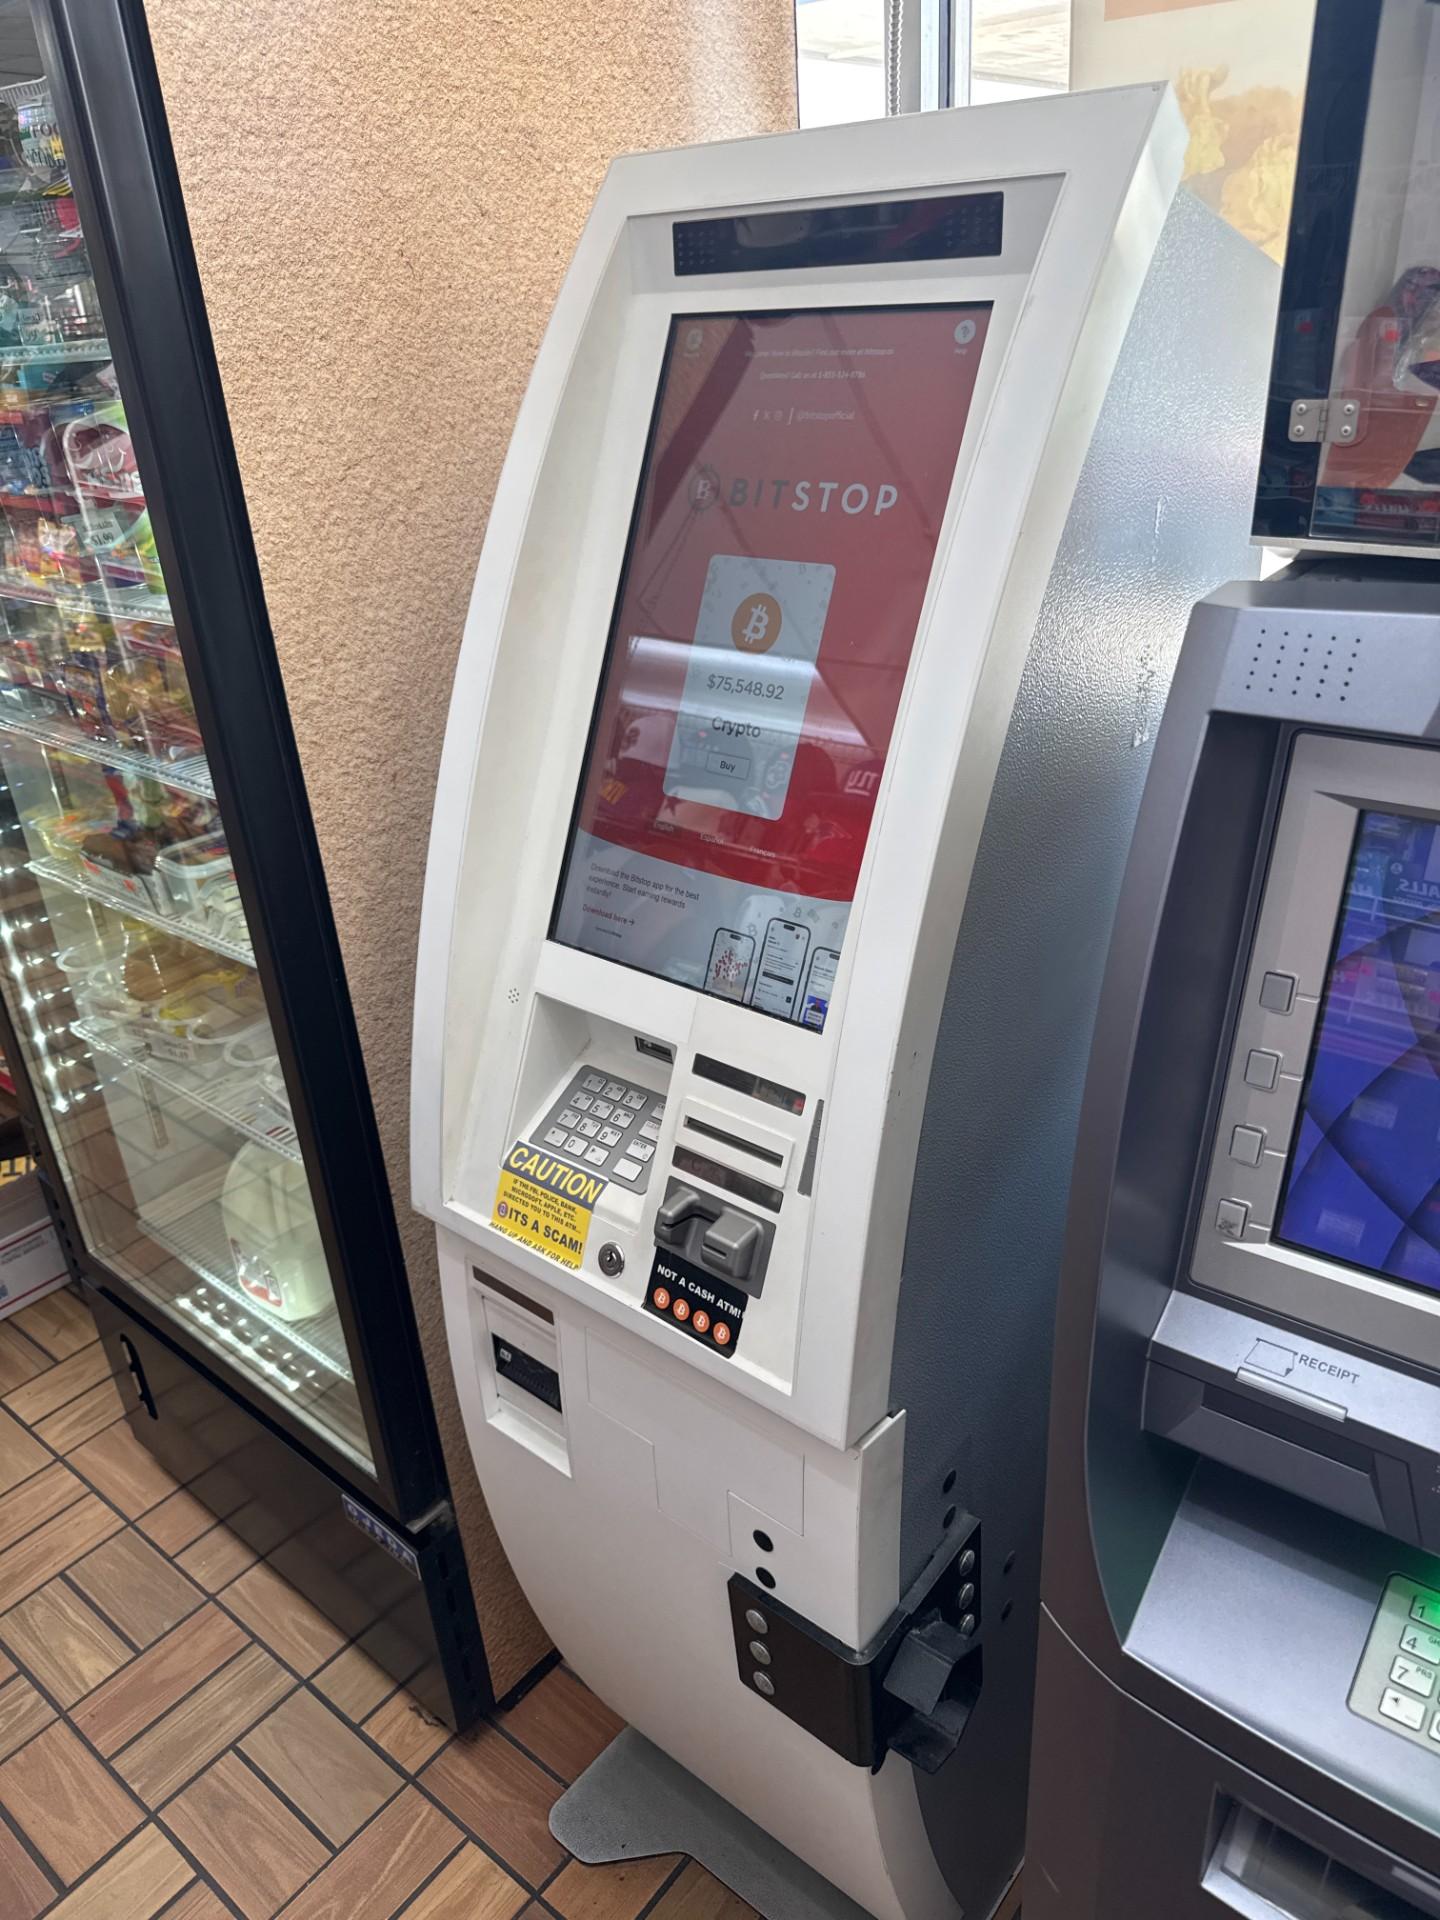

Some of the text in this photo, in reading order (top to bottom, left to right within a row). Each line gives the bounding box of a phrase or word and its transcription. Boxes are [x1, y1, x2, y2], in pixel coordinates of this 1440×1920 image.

[727, 478, 898, 516] BITSTOP
[707, 674, 785, 701] $75,548.92
[711, 717, 761, 739] Crypto
[719, 760, 736, 773] Buy
[622, 883, 637, 895] Start
[652, 881, 664, 891] app
[674, 886, 685, 896] the
[685, 890, 700, 901] best
[582, 904, 628, 925] Download here
[605, 1086, 613, 1096] 2
[572, 1097, 580, 1105] 4
[625, 1095, 634, 1104] 3
[592, 1104, 600, 1113] 5
[613, 1113, 621, 1122] 6
[580, 1123, 588, 1131] 8
[600, 1131, 608, 1140] 9
[567, 1139, 576, 1149] 0
[633, 1140, 647, 1149] ENTER
[509, 1147, 603, 1204] CAUTION
[519, 1180, 529, 1190] THE
[503, 1191, 529, 1208] DIRECTED
[530, 1204, 541, 1213] YOU
[543, 1209, 550, 1218] TO
[551, 1213, 564, 1225] THIS
[508, 1207, 583, 1255] ITS A SCAM!
[488, 1221, 507, 1234] HANG
[508, 1229, 519, 1238] UP
[517, 1236, 532, 1246] AND
[532, 1242, 546, 1255] ASK
[546, 1250, 562, 1262] FOR
[657, 1264, 741, 1319] NOT A CASH ATM!
[1299, 1354, 1360, 1384] RECEIPT
[1417, 1605, 1426, 1619] 1
[1406, 1636, 1418, 1650] 4
[1397, 1665, 1433, 1680] 7 PRS
